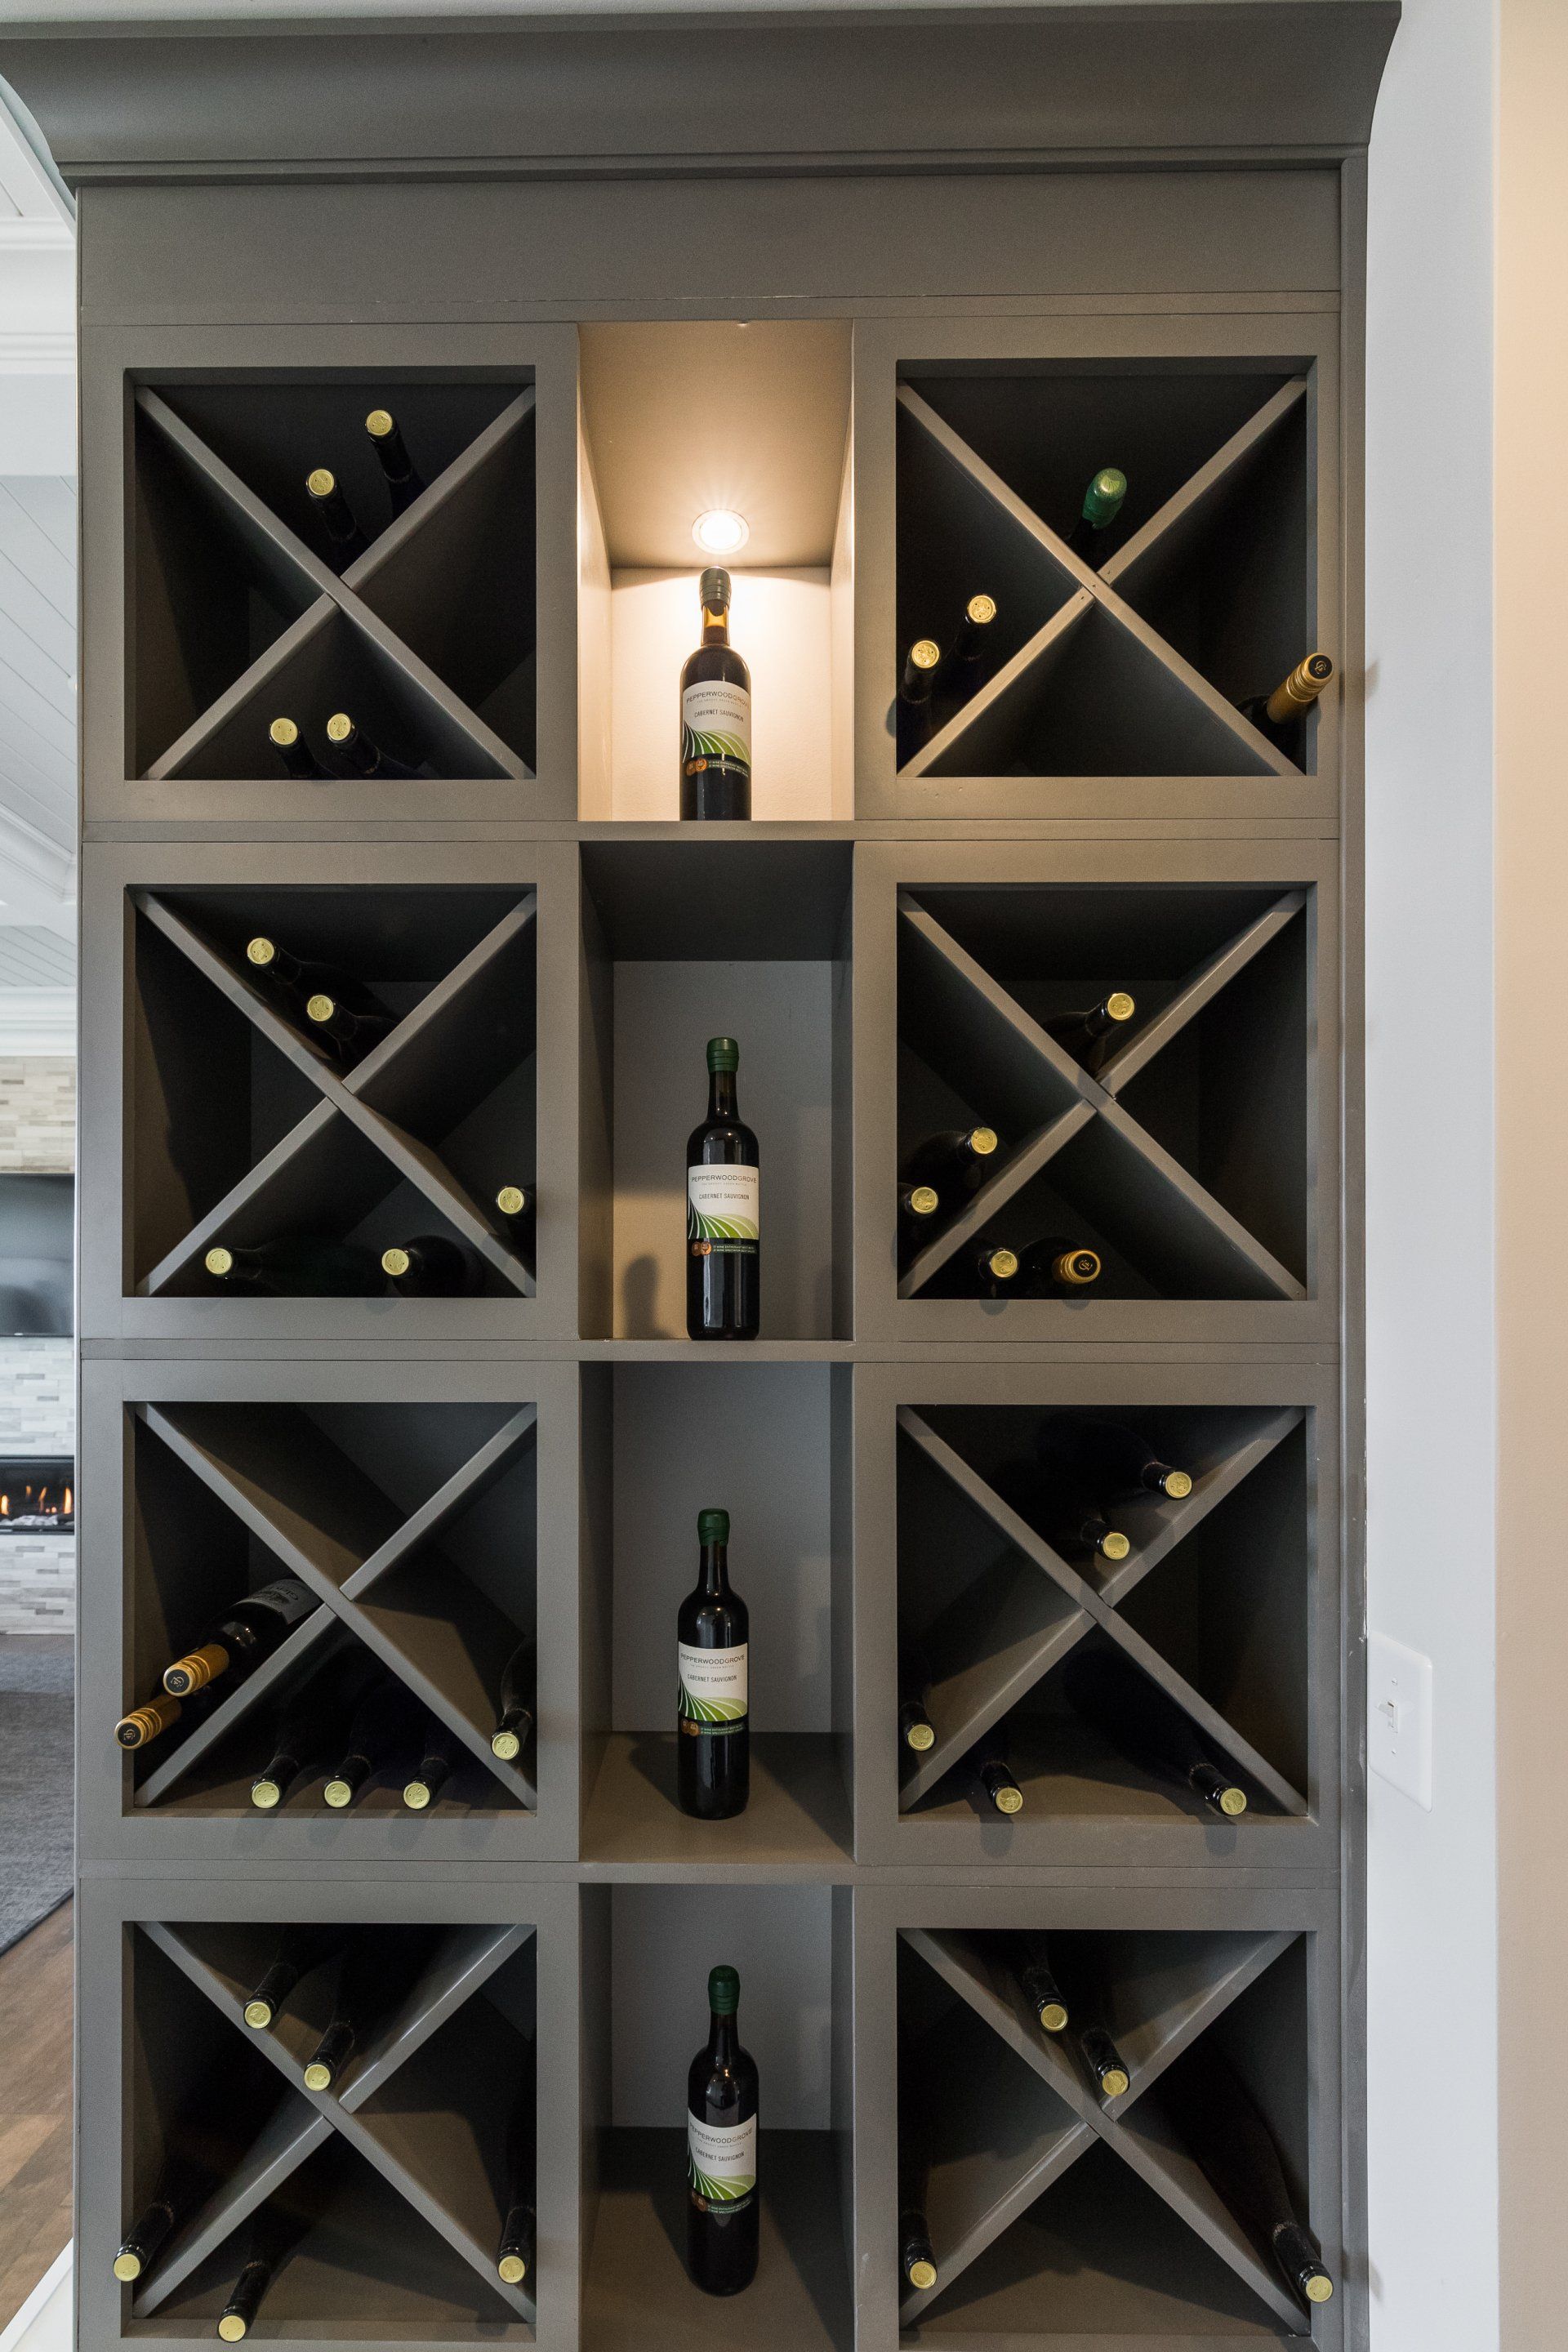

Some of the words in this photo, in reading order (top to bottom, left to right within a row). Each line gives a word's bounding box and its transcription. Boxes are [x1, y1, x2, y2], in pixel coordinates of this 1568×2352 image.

[694, 709, 718, 718] CABERNET
[719, 710, 744, 722] SAUVIGNON
[691, 1174, 757, 1183] PEPPERWOODGROVE
[680, 1653, 745, 1664] PEPPERWOODGROVE
[687, 1673, 710, 1682] CABERNET
[711, 1674, 737, 1682] SAUVIGNON
[695, 2147, 717, 2161] CABERNET
[718, 2151, 745, 2162] SAUVIGNON
